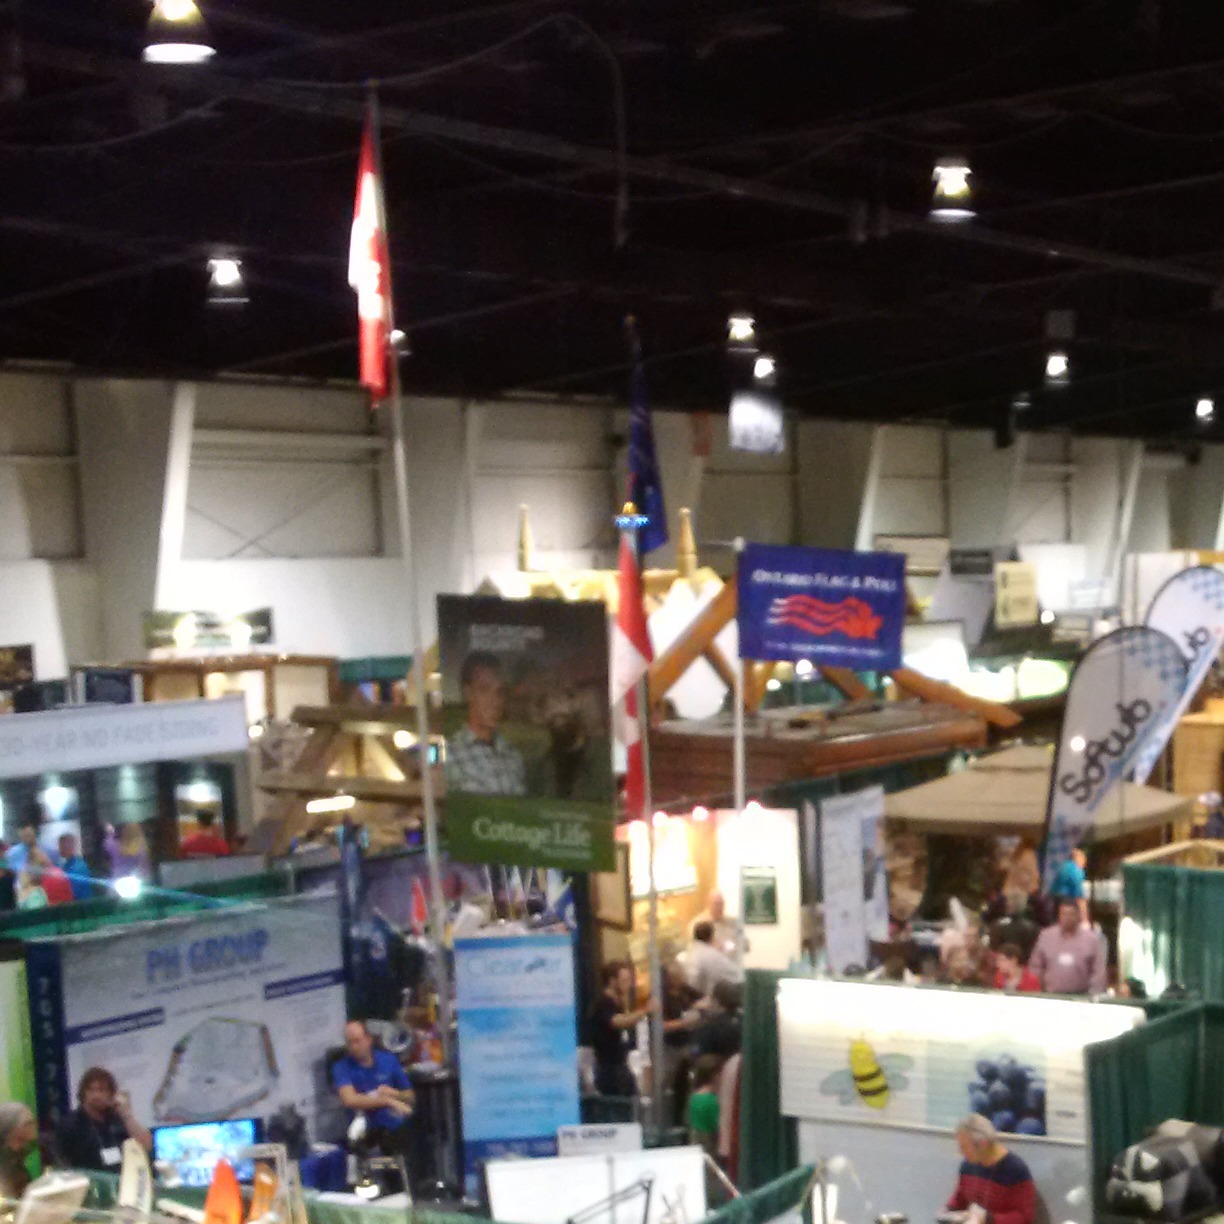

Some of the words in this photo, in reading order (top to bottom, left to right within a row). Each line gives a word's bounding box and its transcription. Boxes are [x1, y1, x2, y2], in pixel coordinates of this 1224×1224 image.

[471, 817, 551, 850] Cottage
[147, 943, 183, 983] PH
[187, 928, 270, 975] GROUP
